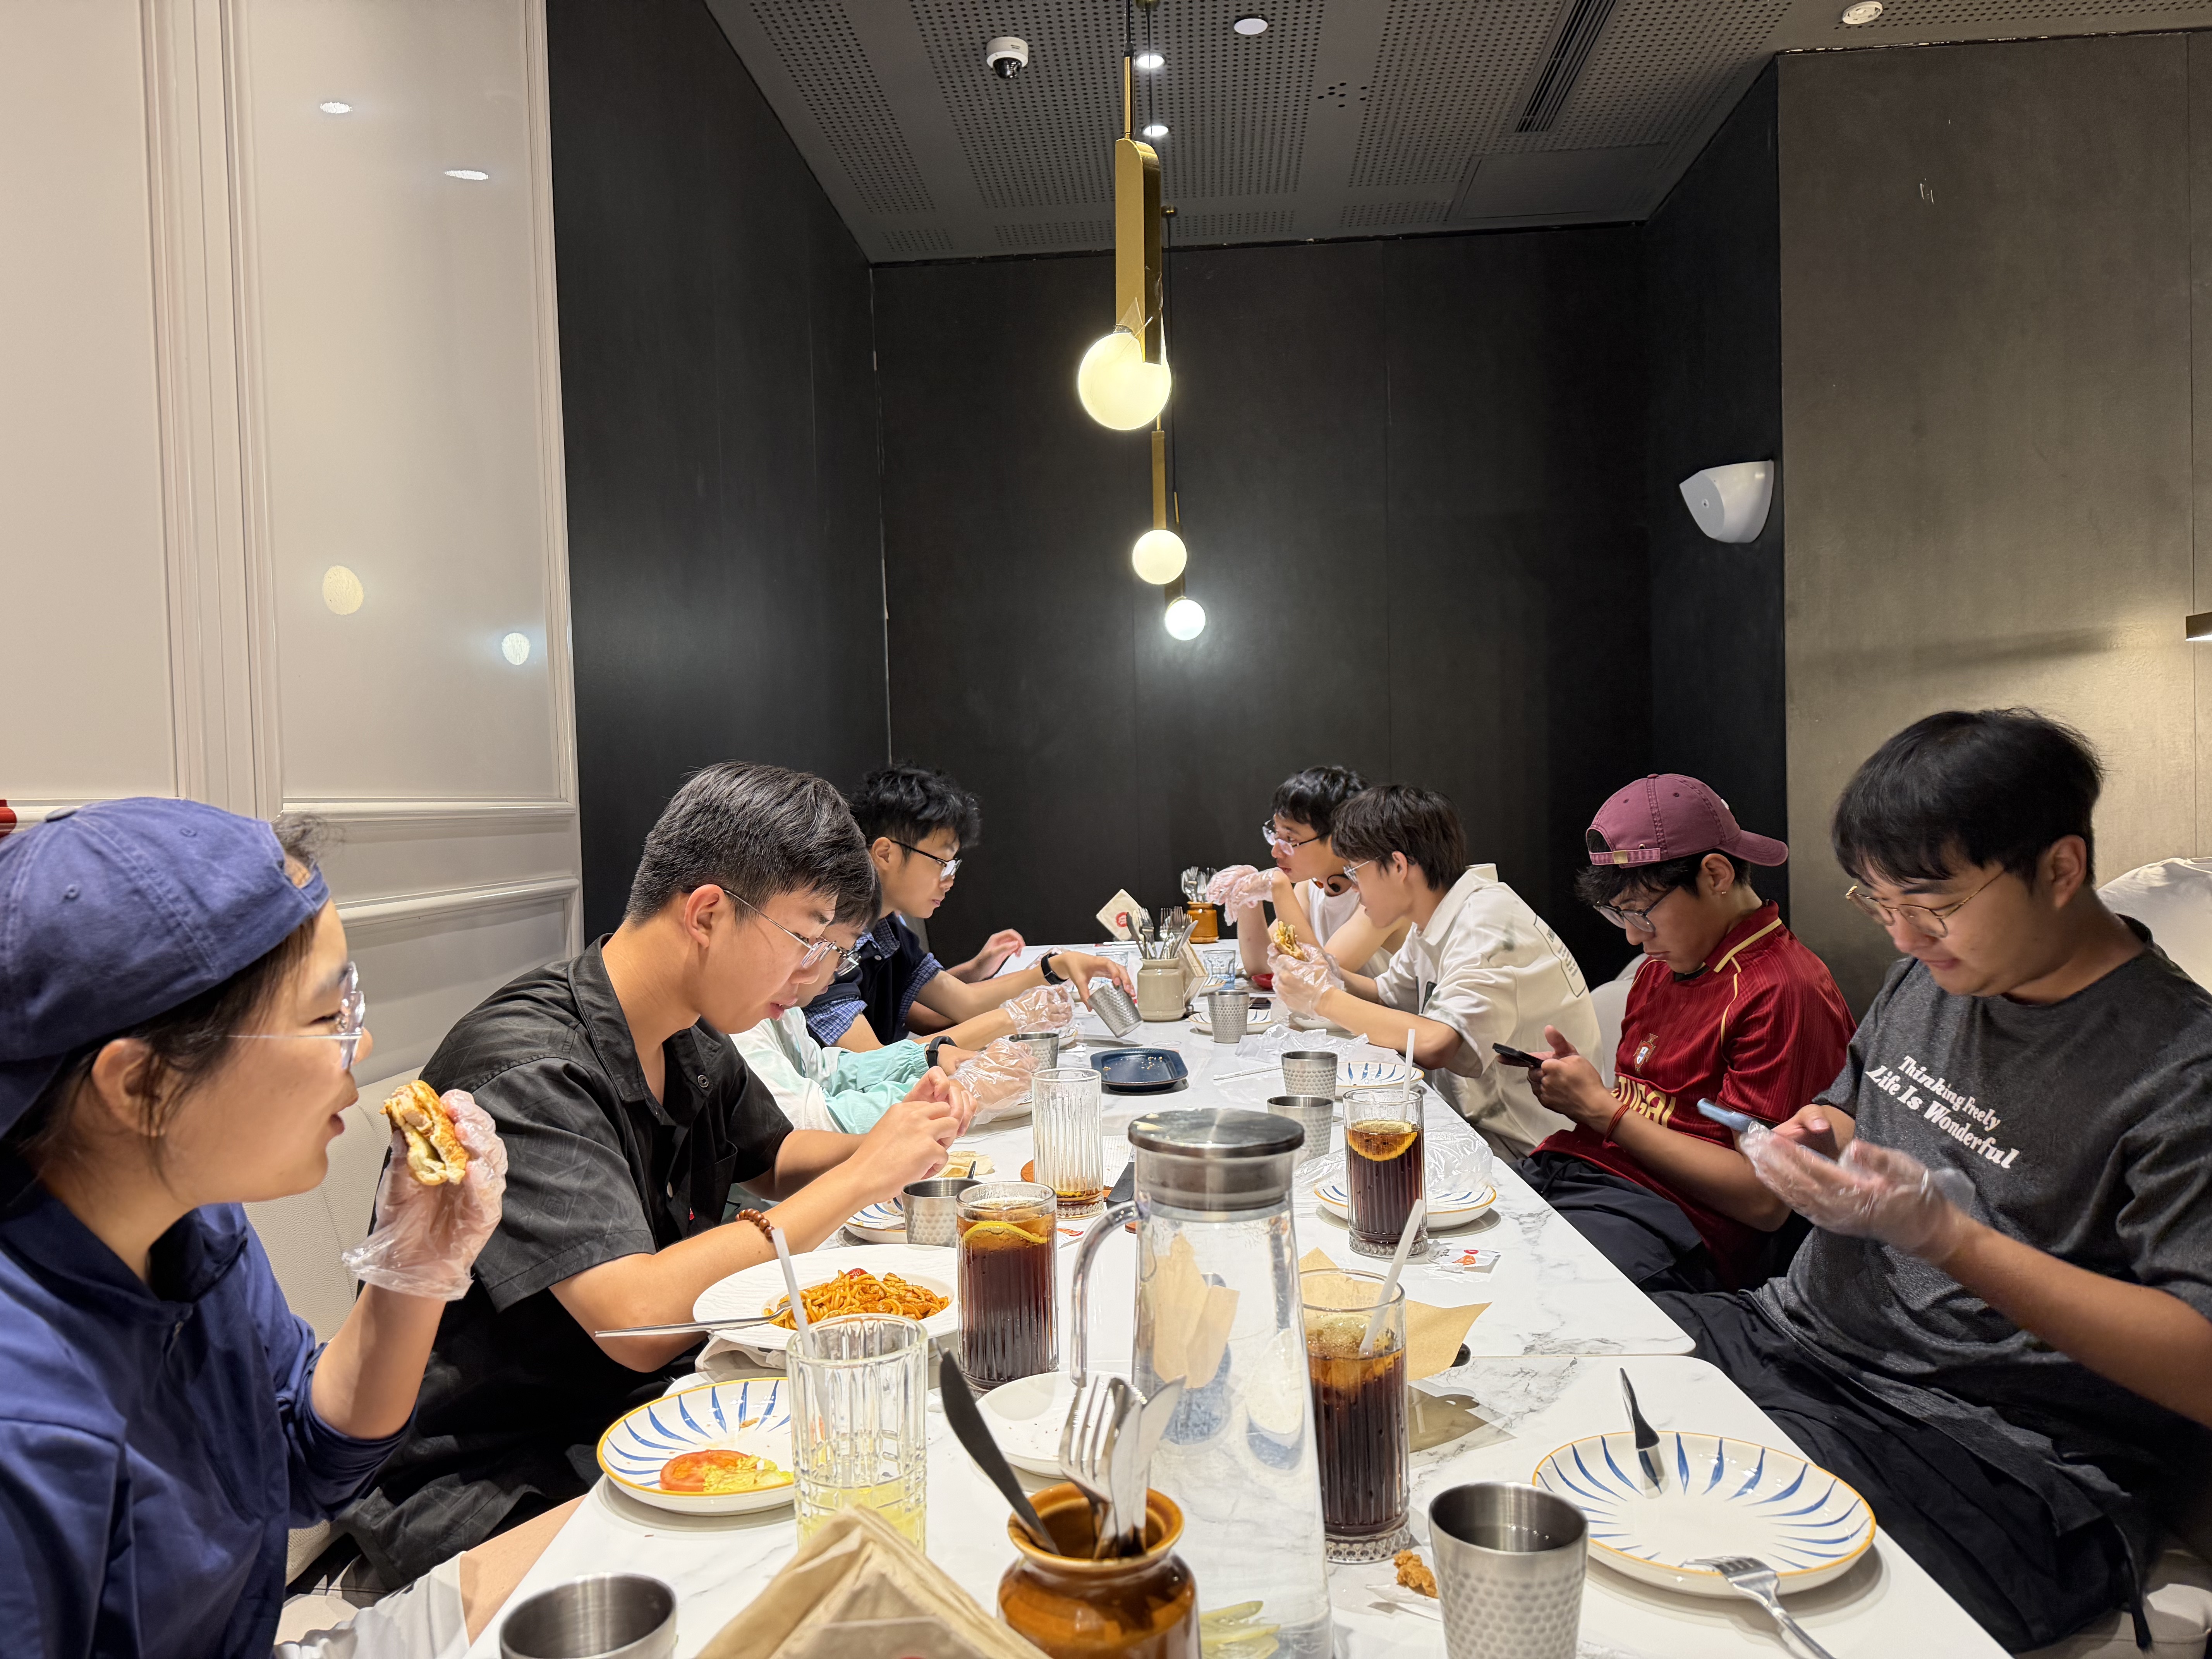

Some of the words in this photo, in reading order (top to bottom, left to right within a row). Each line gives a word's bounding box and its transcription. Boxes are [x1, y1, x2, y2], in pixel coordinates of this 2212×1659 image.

[1865, 1065, 1901, 1095] Life
[1897, 1085, 1923, 1110] Is
[1923, 1101, 2020, 1169] Wonderful
[1898, 1055, 1966, 1111] Thinking
[1962, 1096, 2001, 1132] Freely
